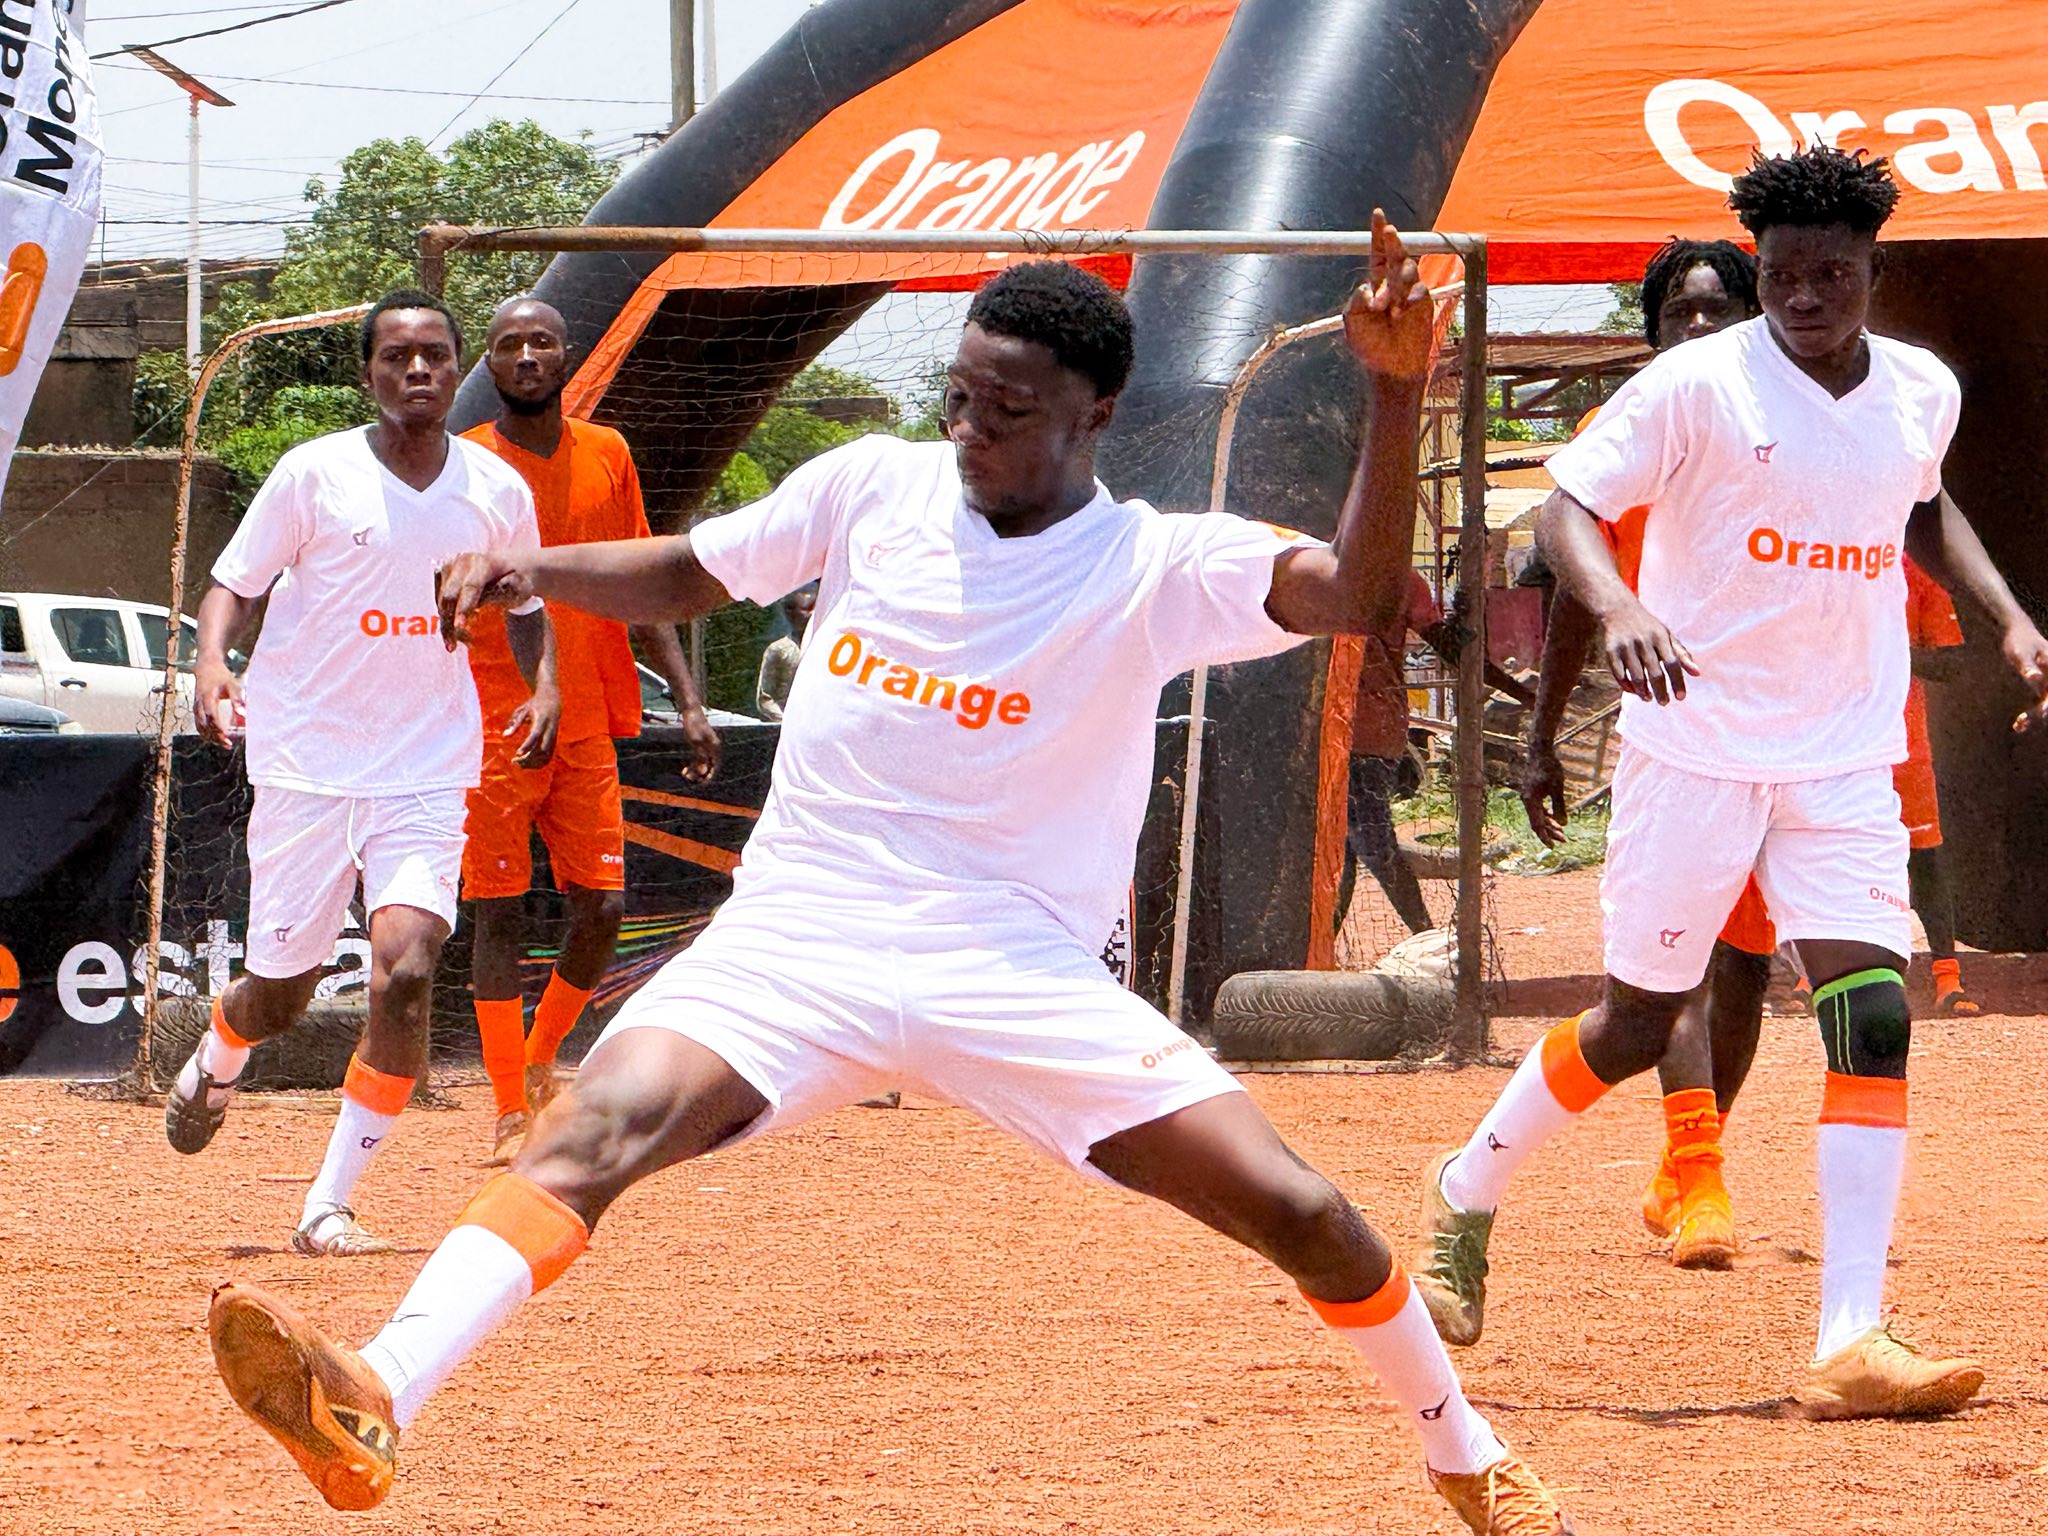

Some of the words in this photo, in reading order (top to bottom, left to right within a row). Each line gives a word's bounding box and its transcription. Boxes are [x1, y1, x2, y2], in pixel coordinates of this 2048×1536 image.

[14, 0, 76, 194] Mone
[820, 128, 1146, 259] Orange
[1748, 528, 1896, 580] Orange
[828, 633, 1031, 730] Orange
